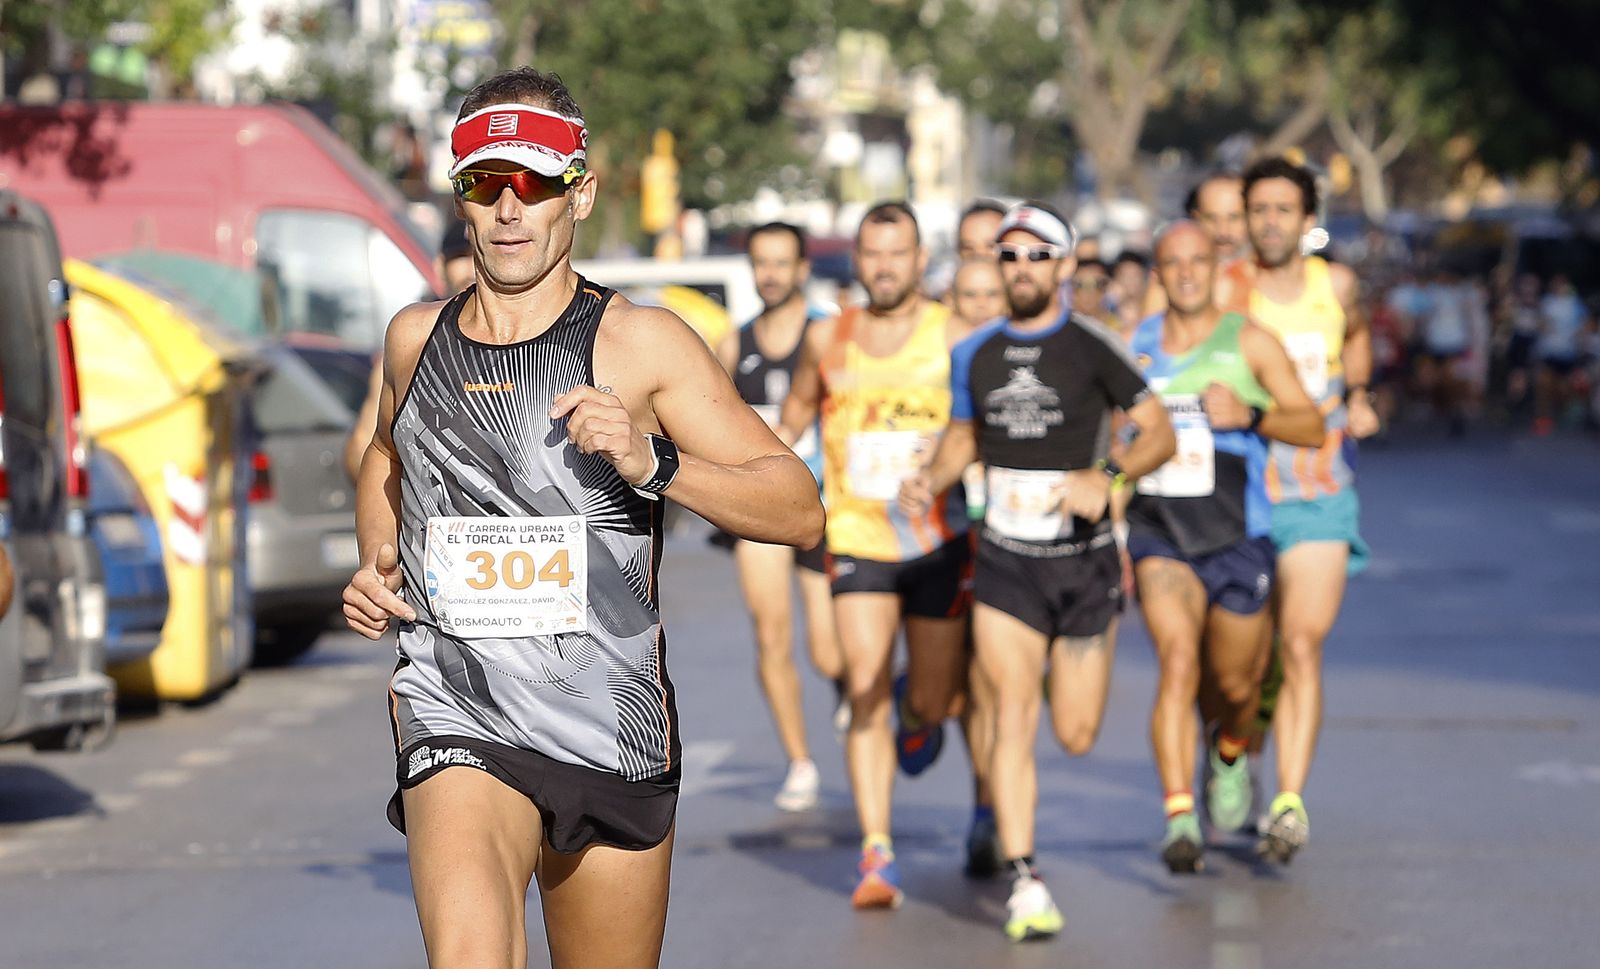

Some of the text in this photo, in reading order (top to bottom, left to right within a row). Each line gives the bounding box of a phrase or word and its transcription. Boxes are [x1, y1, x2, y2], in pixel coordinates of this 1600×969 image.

[448, 521, 564, 533] VII CARRERA URBANA
[447, 533, 565, 544] EL TORCAL LA PAZ
[464, 549, 575, 590] 304
[531, 596, 556, 604] DAVID
[454, 617, 522, 627] DISMOAUTO
